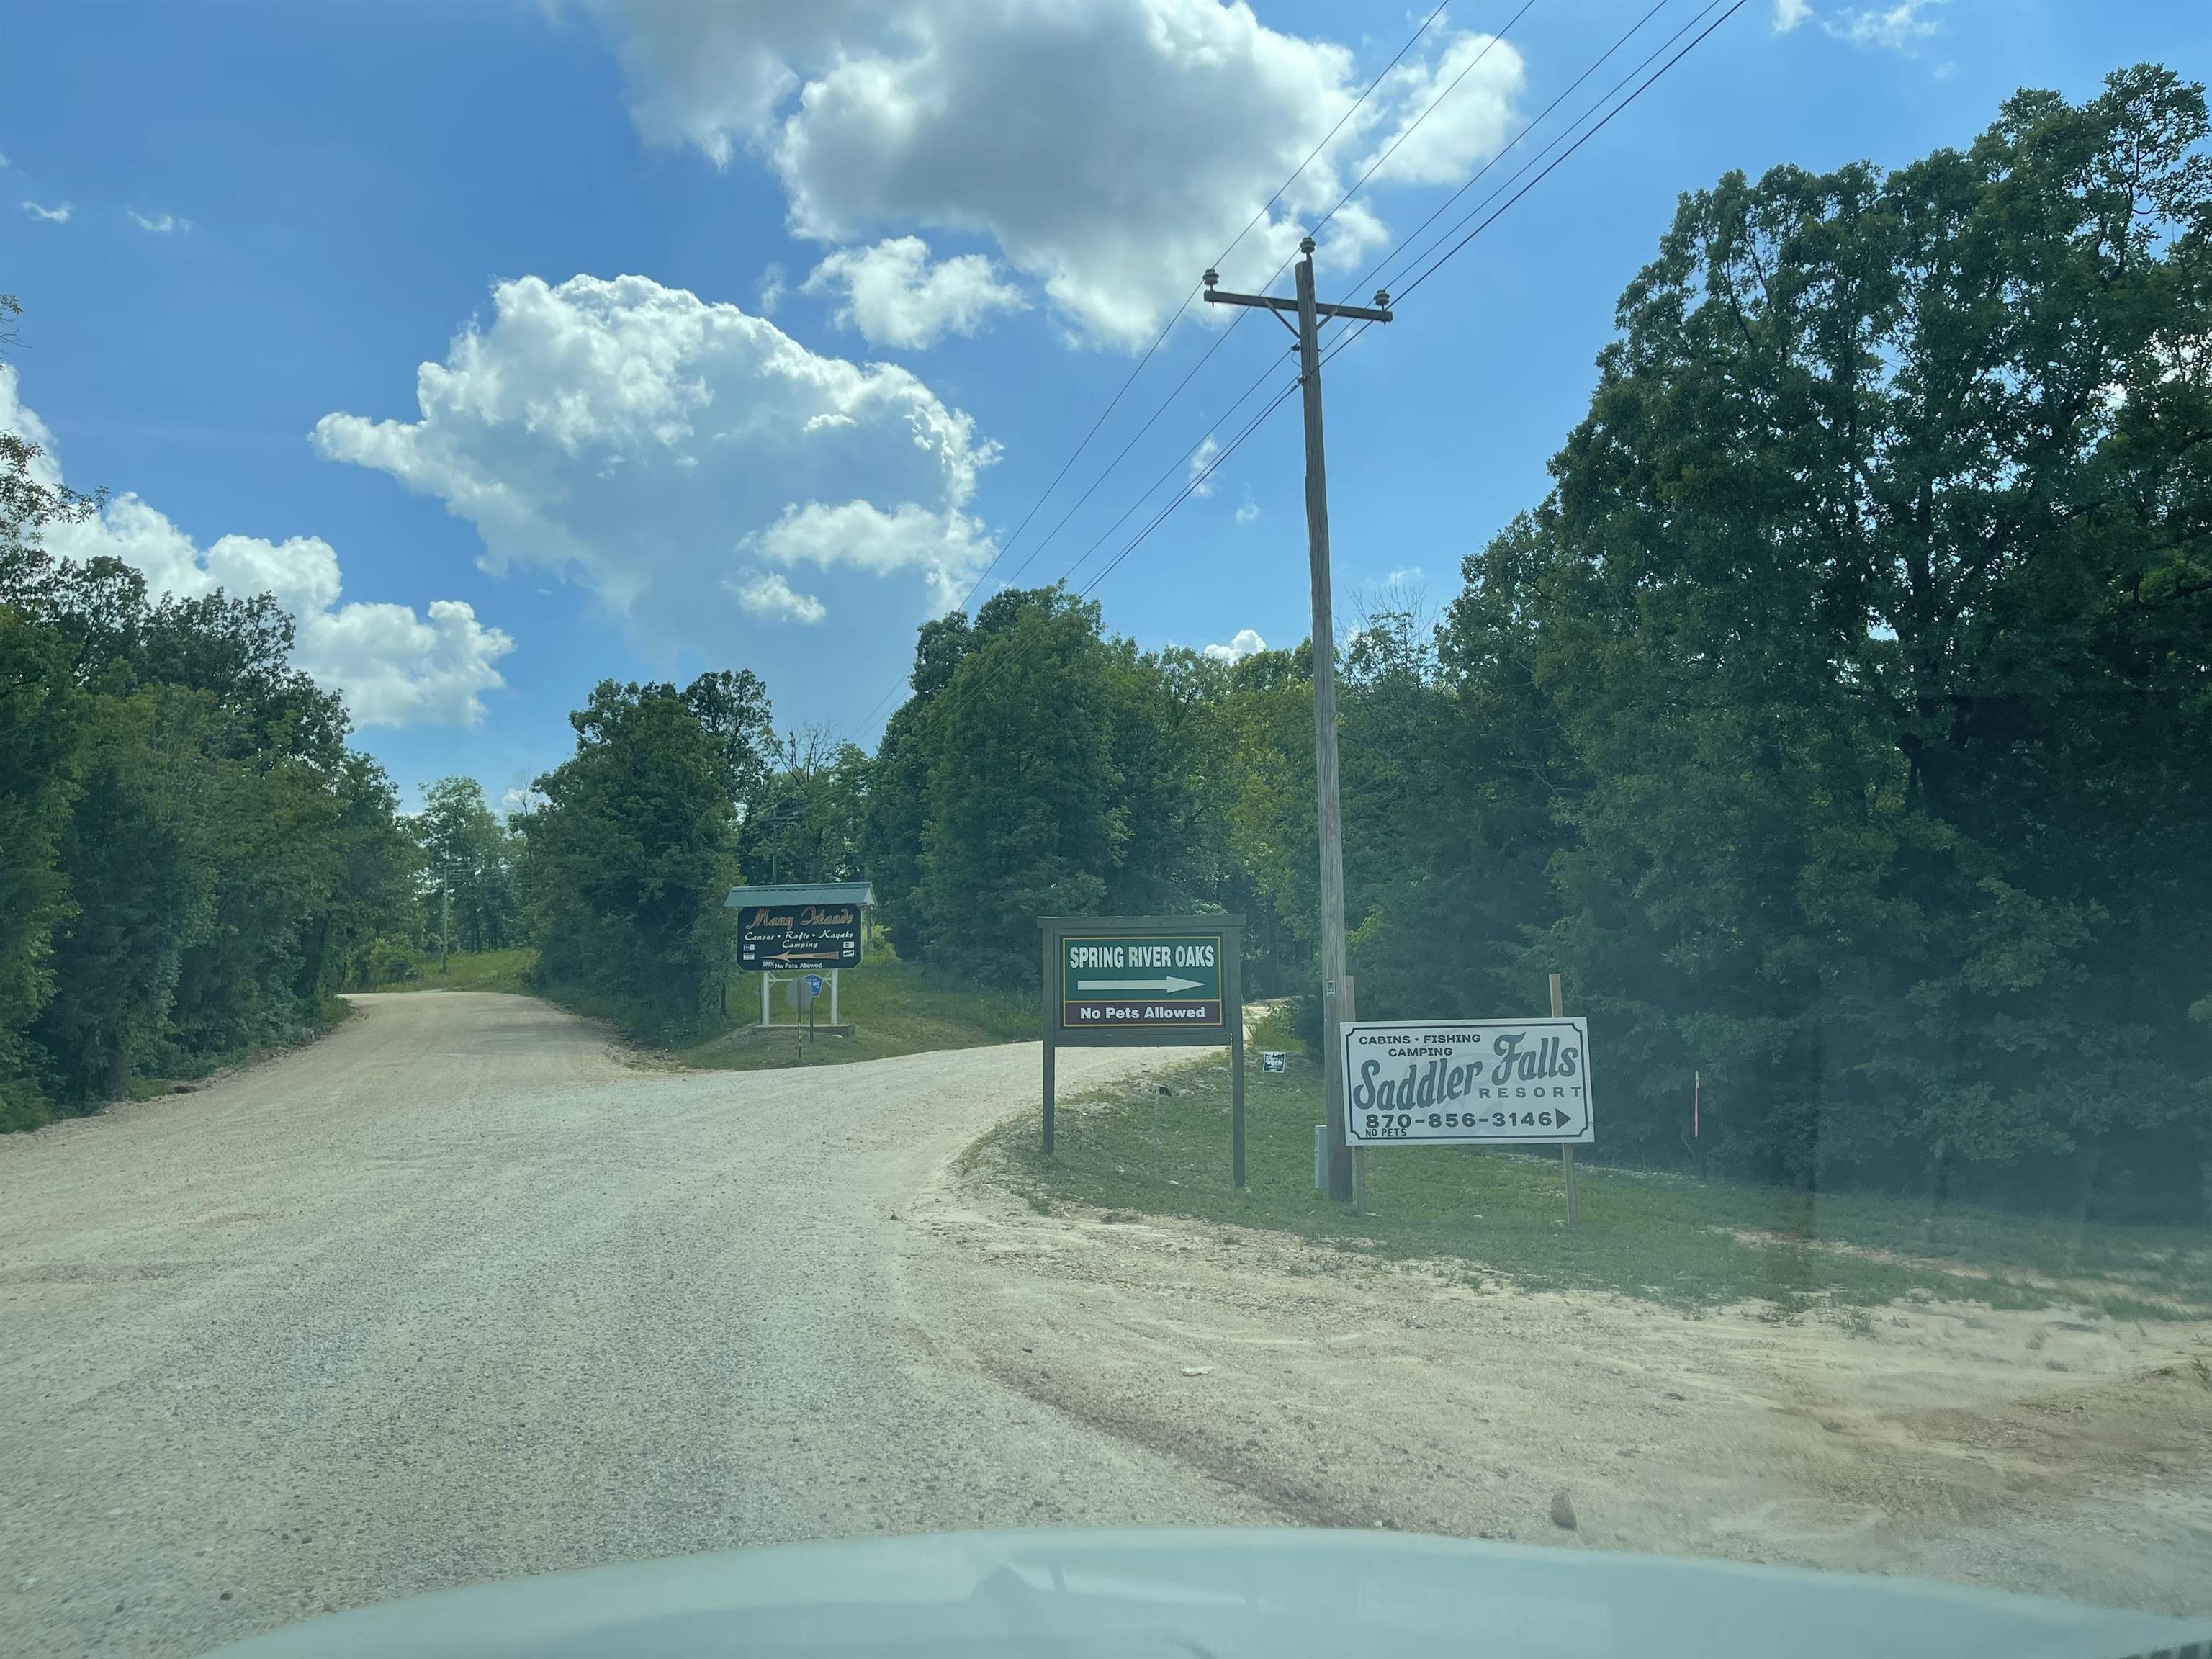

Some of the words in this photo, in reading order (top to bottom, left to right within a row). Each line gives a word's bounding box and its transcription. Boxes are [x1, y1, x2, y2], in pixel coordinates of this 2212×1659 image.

[801, 906, 853, 926] Islands
[819, 930, 853, 940] Kayaks
[782, 940, 818, 949] Camping
[1070, 946, 1124, 968] SPRING
[1128, 946, 1172, 967] RIVER
[1175, 945, 1214, 967] OAKS
[1080, 1008, 1101, 1019] No
[1105, 1007, 1140, 1019] Pets
[1144, 1007, 1205, 1018] Allowed
[1359, 1035, 1411, 1045] CABINS
[1424, 1034, 1481, 1043] FISHING
[1388, 1048, 1453, 1057] CAMPING
[1353, 1058, 1483, 1111] Saddler
[1491, 1031, 1579, 1086] Falls
[1479, 1087, 1581, 1098] RESORT
[1365, 1112, 1552, 1128] 870-856-3146
[1381, 1128, 1406, 1137] PETS
